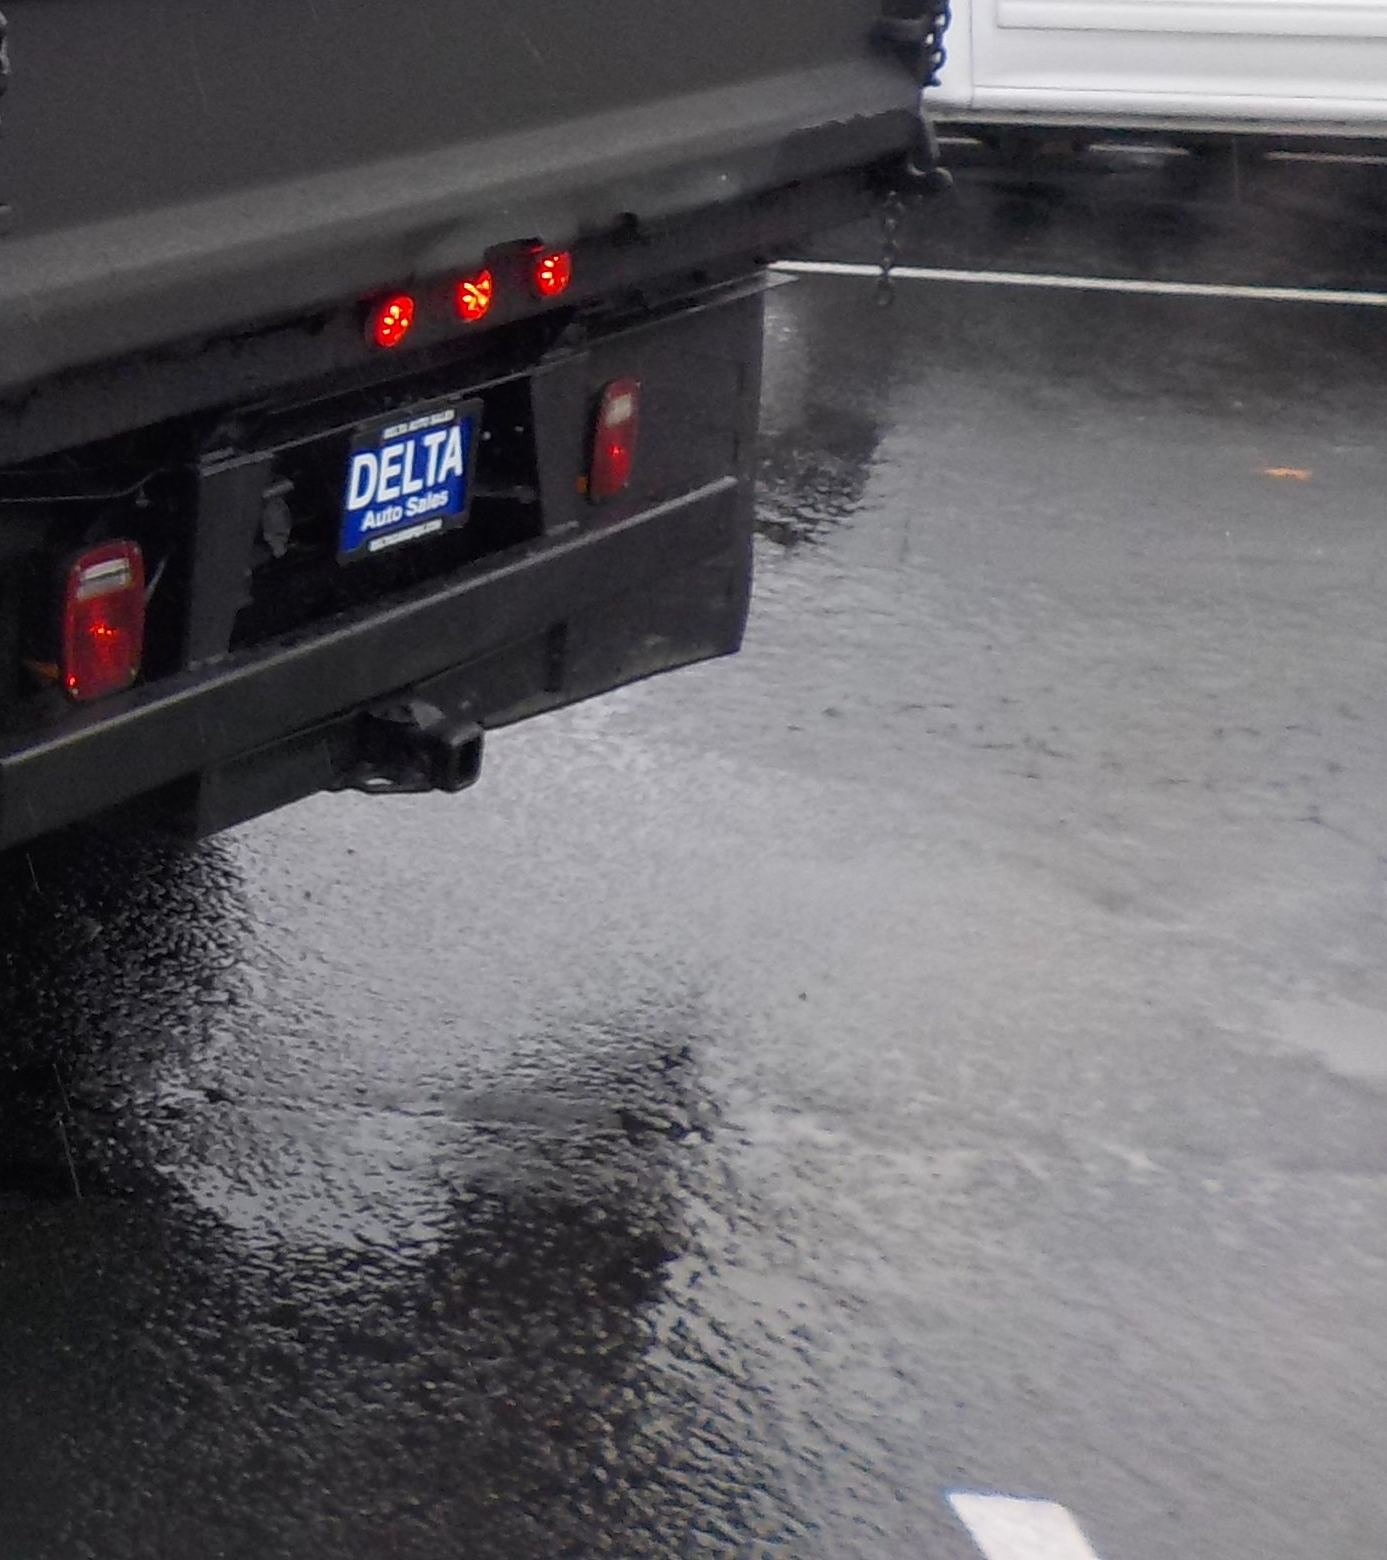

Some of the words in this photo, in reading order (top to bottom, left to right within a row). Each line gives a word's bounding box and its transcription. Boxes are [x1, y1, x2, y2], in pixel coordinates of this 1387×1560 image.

[346, 425, 464, 511] DELTA
[360, 505, 403, 532] Auto
[404, 489, 449, 517] Sales
